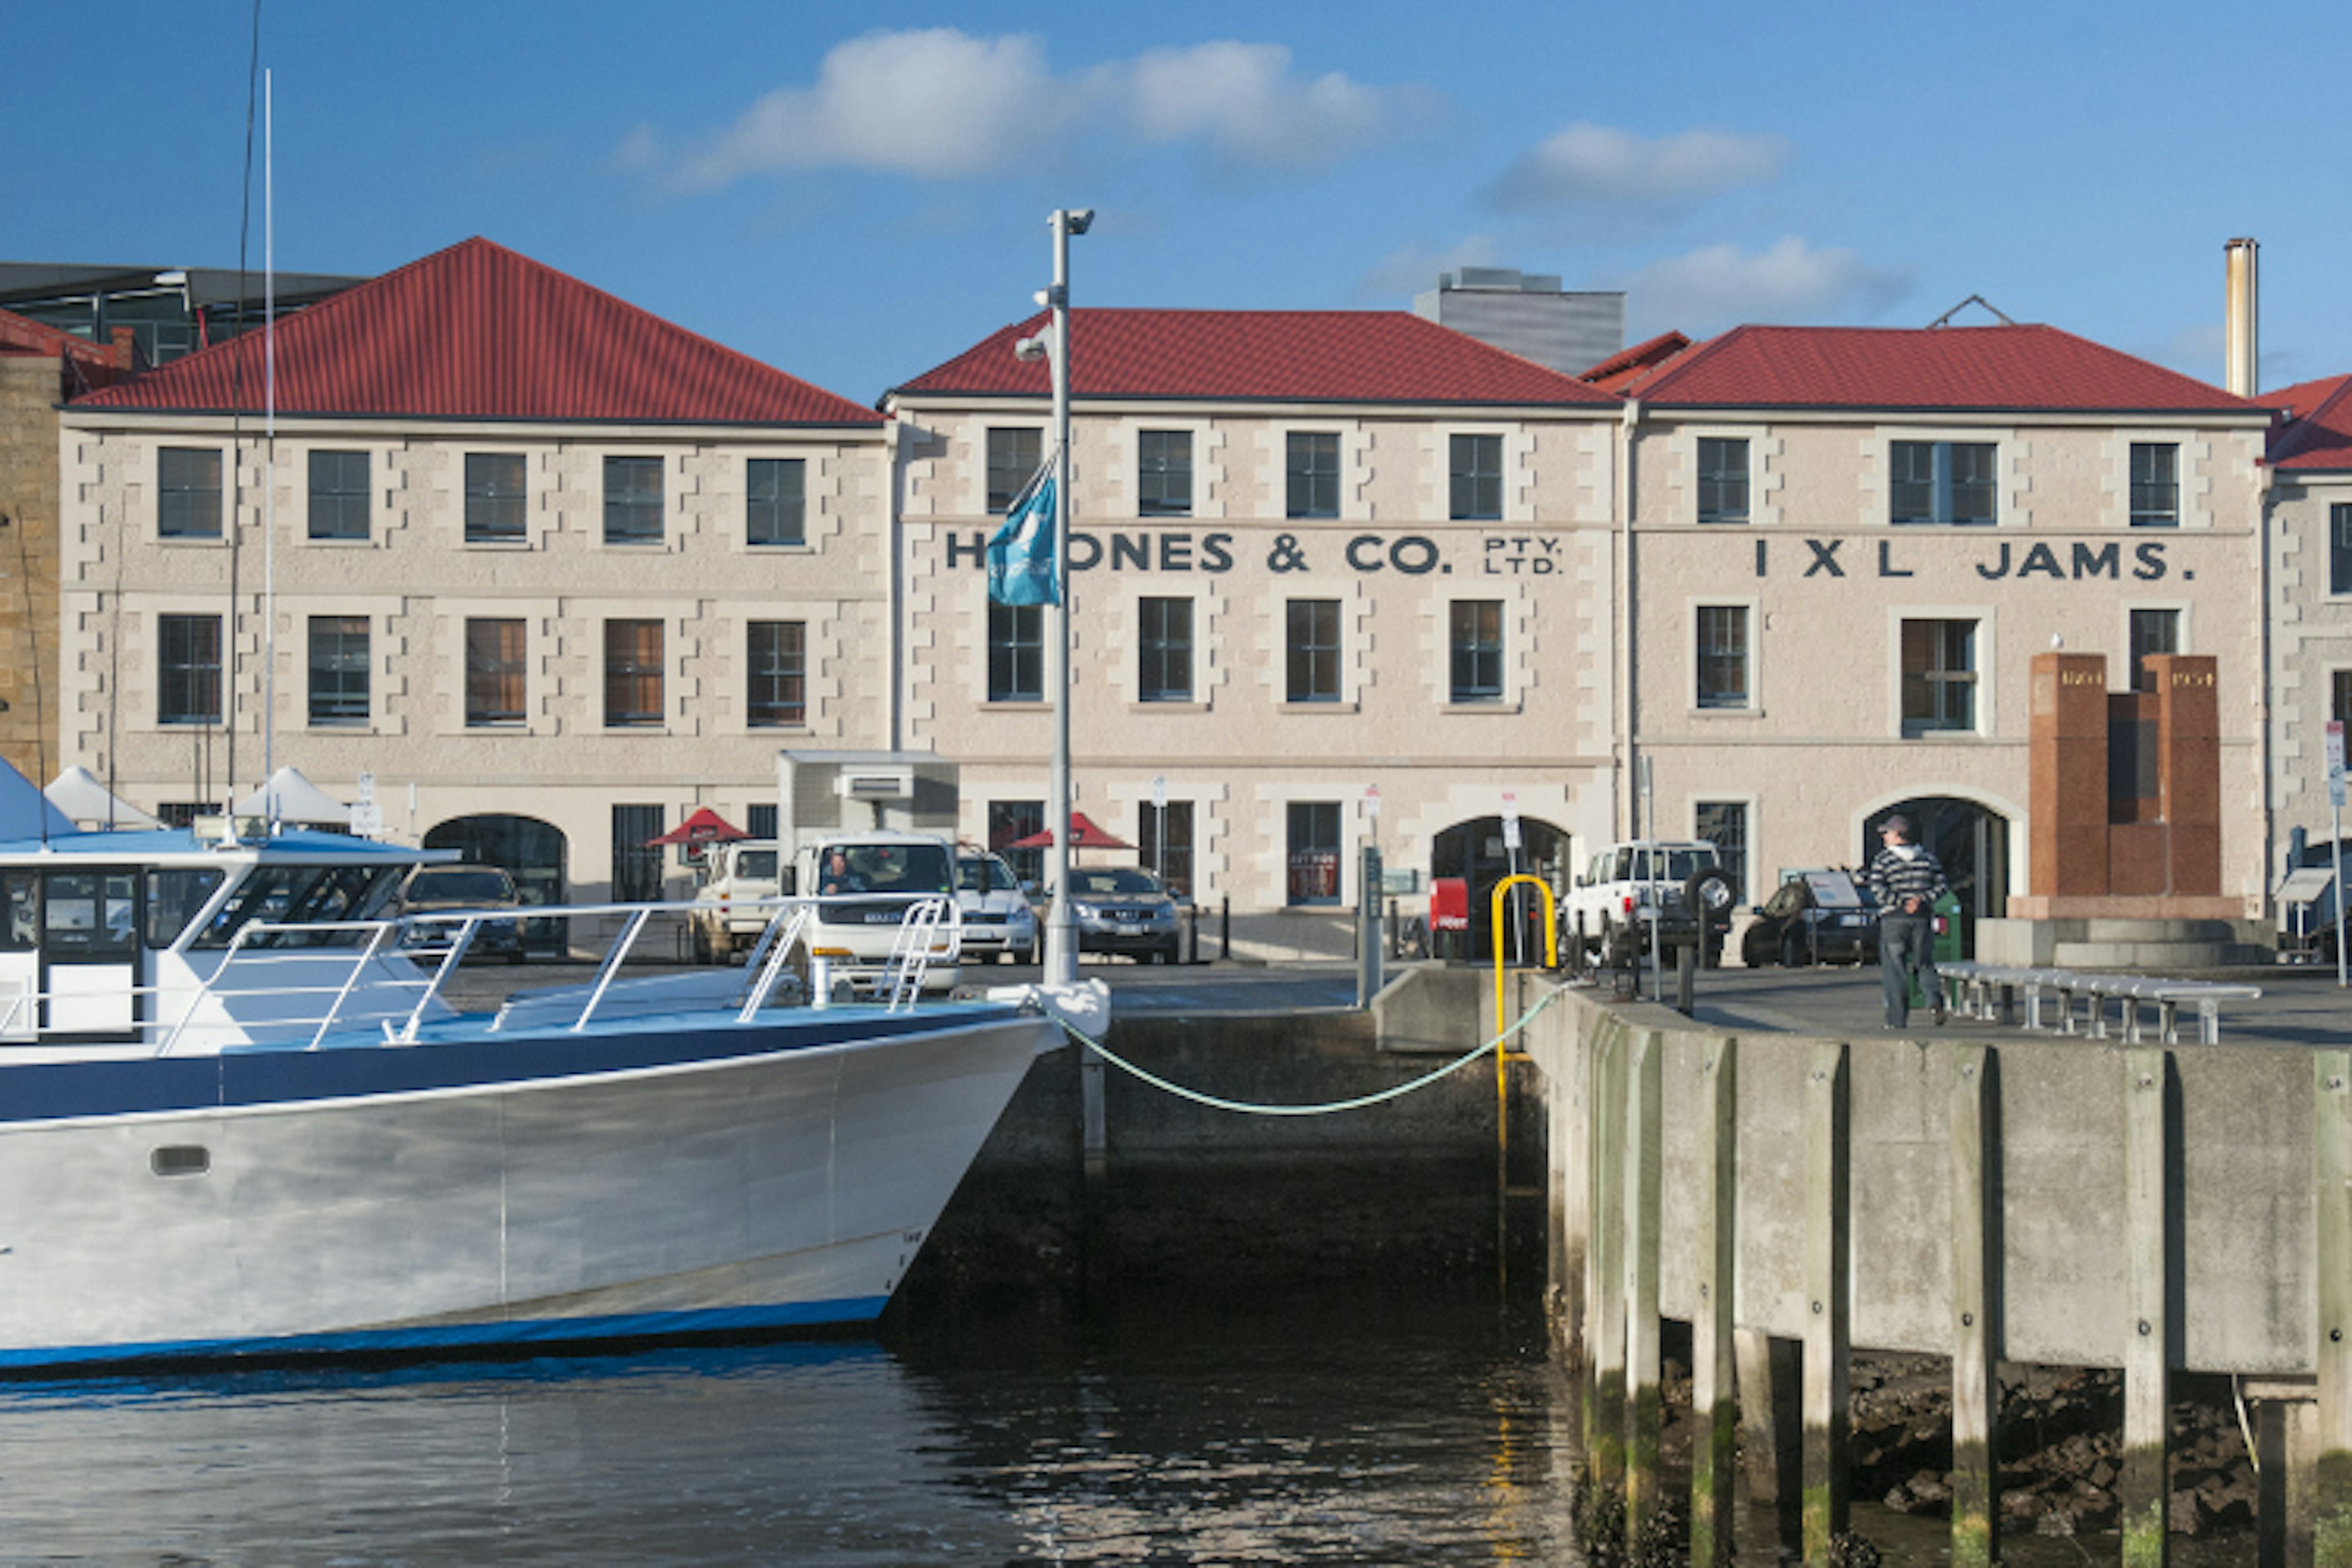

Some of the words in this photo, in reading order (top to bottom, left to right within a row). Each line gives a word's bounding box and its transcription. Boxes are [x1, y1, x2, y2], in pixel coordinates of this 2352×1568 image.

[1068, 532, 1234, 573] ONES
[1267, 533, 1310, 573] &
[1346, 535, 1452, 575] CO.
[1485, 538, 1562, 554] PTY.
[1485, 558, 1562, 575] LTD.
[1975, 542, 2194, 581] JAMS.
